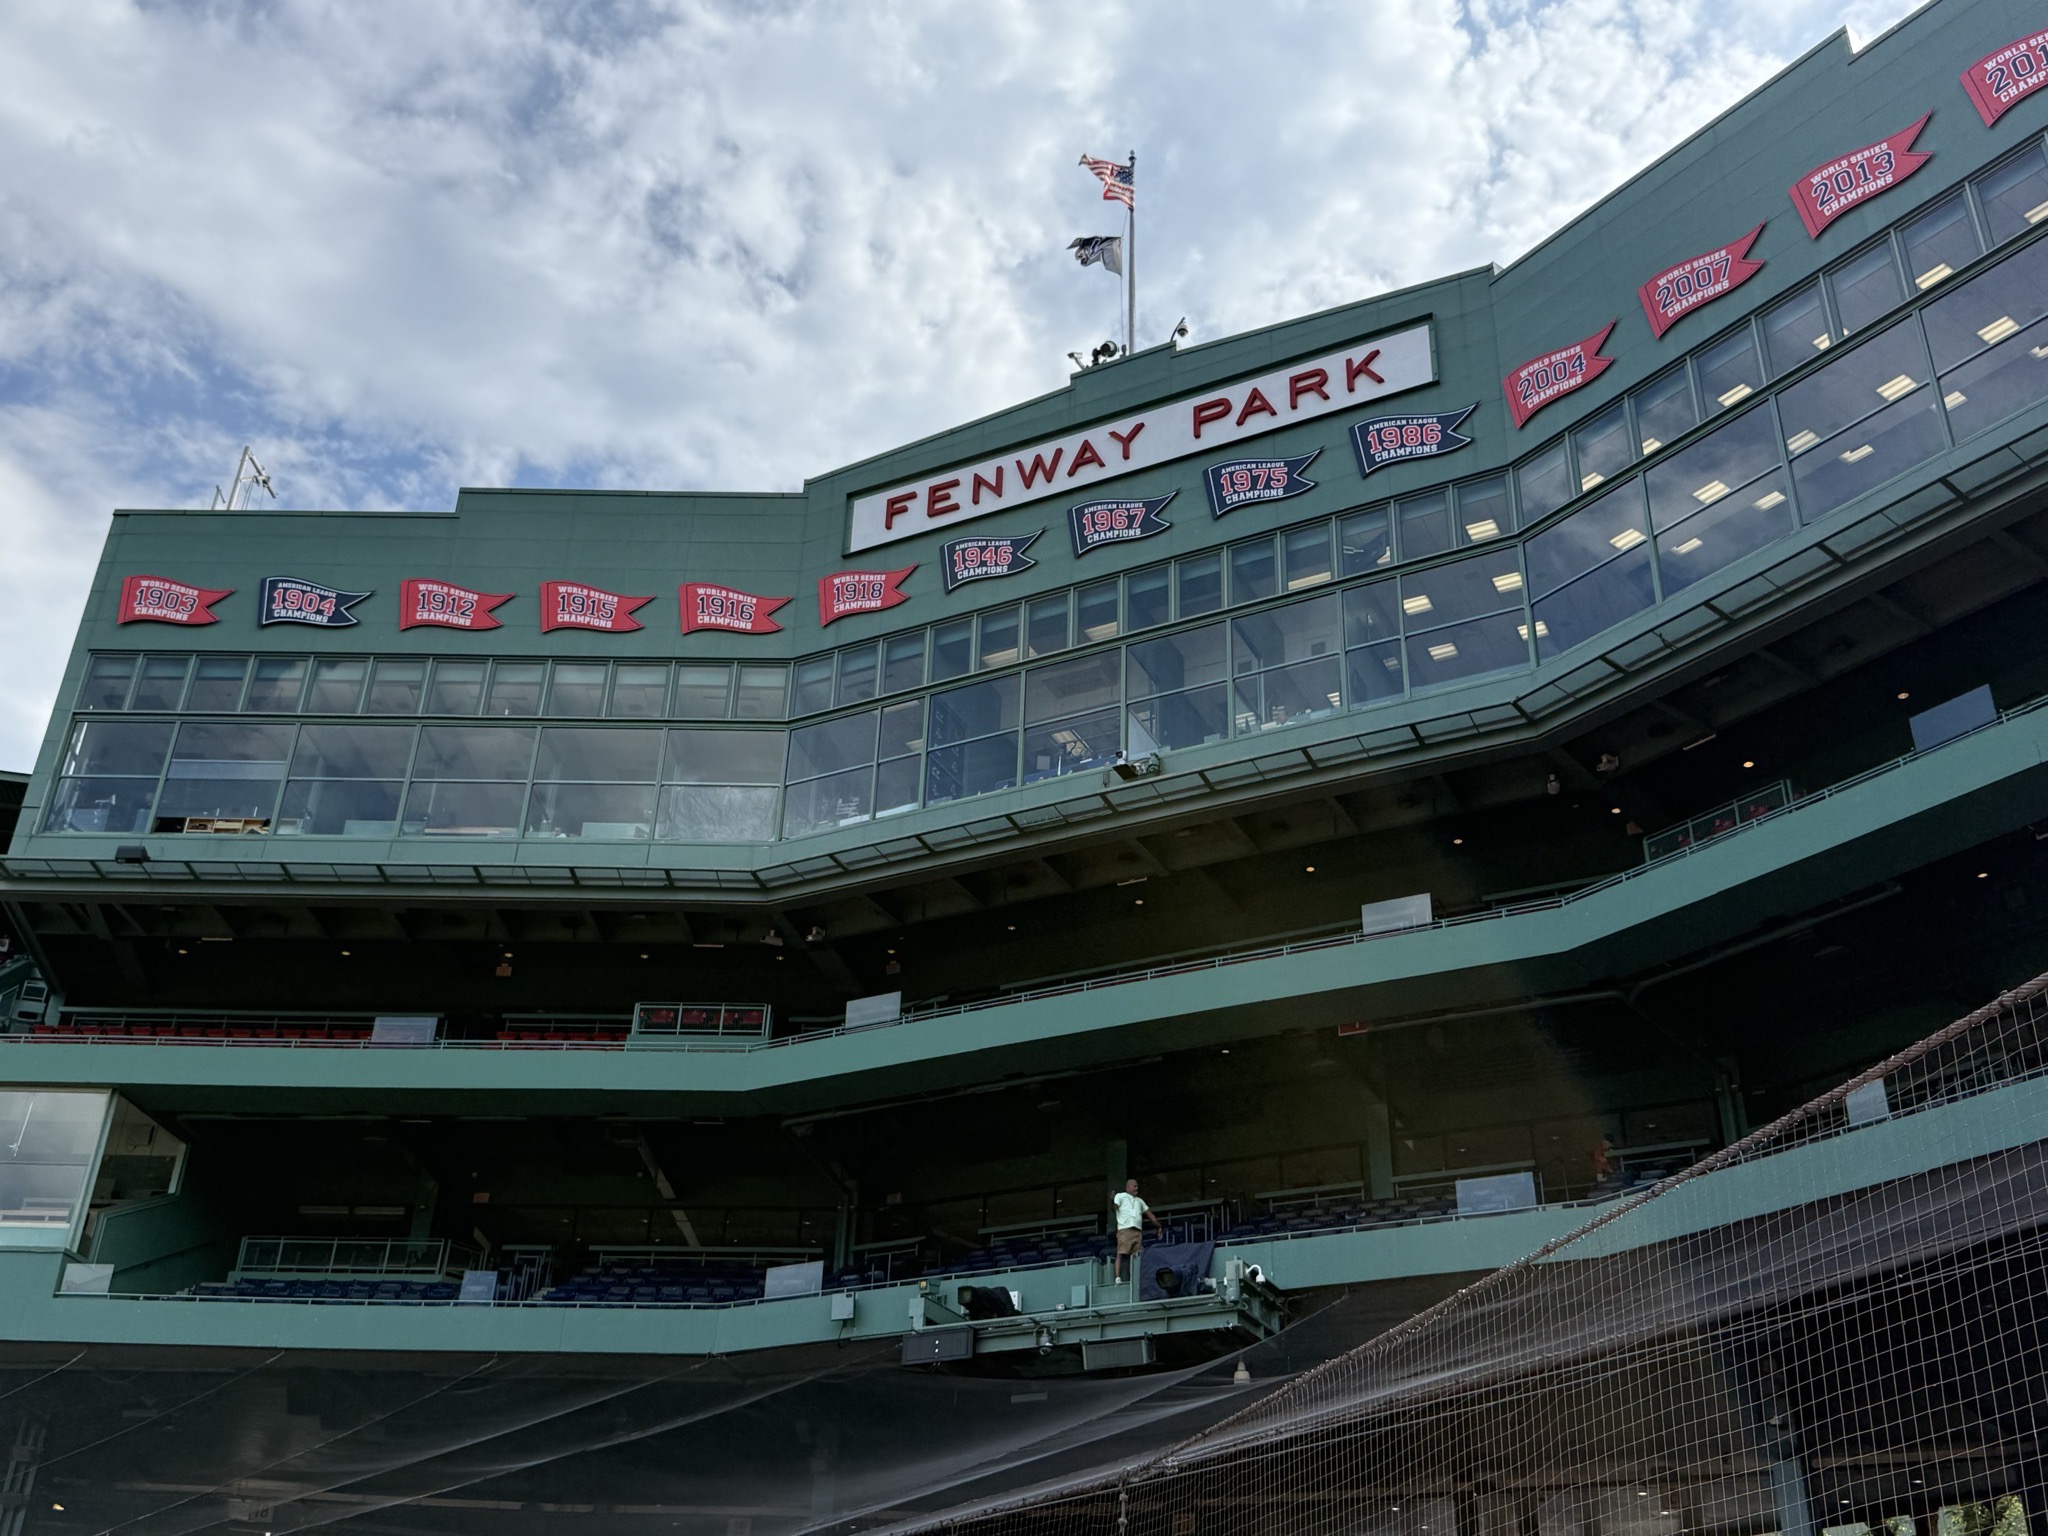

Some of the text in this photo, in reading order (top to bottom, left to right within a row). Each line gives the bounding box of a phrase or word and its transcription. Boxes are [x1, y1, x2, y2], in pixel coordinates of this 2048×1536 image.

[1984, 43, 2027, 70] WORLD
[2000, 69, 2048, 102] CHAMP
[1811, 142, 1888, 184] WORLD SERIES
[1812, 150, 1894, 210] 2013
[1824, 174, 1893, 216] CHAMPIONS
[1657, 250, 1726, 286] WORLD SERIES
[1656, 255, 1731, 313] 2007
[1668, 280, 1729, 317] CHAMPIONS
[1519, 346, 1580, 378] WORLD SERIES
[1518, 352, 1586, 404] 2004
[1527, 375, 1582, 408] CHAMPIONS
[1369, 420, 1407, 431] AMERICAN
[884, 348, 1385, 530] FENWAY PARK
[1367, 424, 1441, 454] 1986
[1375, 444, 1437, 461] CHAMPIONS
[1221, 464, 1257, 474] AMERICAN
[1220, 468, 1287, 496] 1975
[1226, 488, 1283, 504] CHAMPIONS
[1084, 504, 1117, 514] AMERICAN
[1082, 508, 1145, 535] 1967
[955, 541, 986, 550] AMERICAN
[1087, 528, 1141, 543] CHAMPIONS
[954, 546, 1012, 572] 1946
[833, 576, 859, 585] WORLD
[957, 565, 1008, 579] CHAMPIONS
[141, 580, 198, 596] WORLD SERIES
[277, 582, 336, 597] AMERICAN LEAGUE
[418, 584, 478, 600] WORLD SERIES
[558, 586, 618, 602] WORLD SERIES
[697, 588, 757, 604] WORLD SERIES
[834, 582, 884, 604] 1918
[134, 587, 198, 613] 1903
[272, 589, 336, 616] 1904
[418, 592, 476, 617] 1912
[558, 594, 617, 620] 1915
[698, 596, 755, 621] 1916
[834, 600, 881, 613] CHAMPIONS
[135, 608, 188, 621] CHAMPIONS
[274, 609, 328, 623] CHAMPIONS
[416, 611, 471, 626] CHAMPIONS
[557, 614, 612, 628] CHAMPIONS
[698, 616, 752, 629] CHAMPIONS
